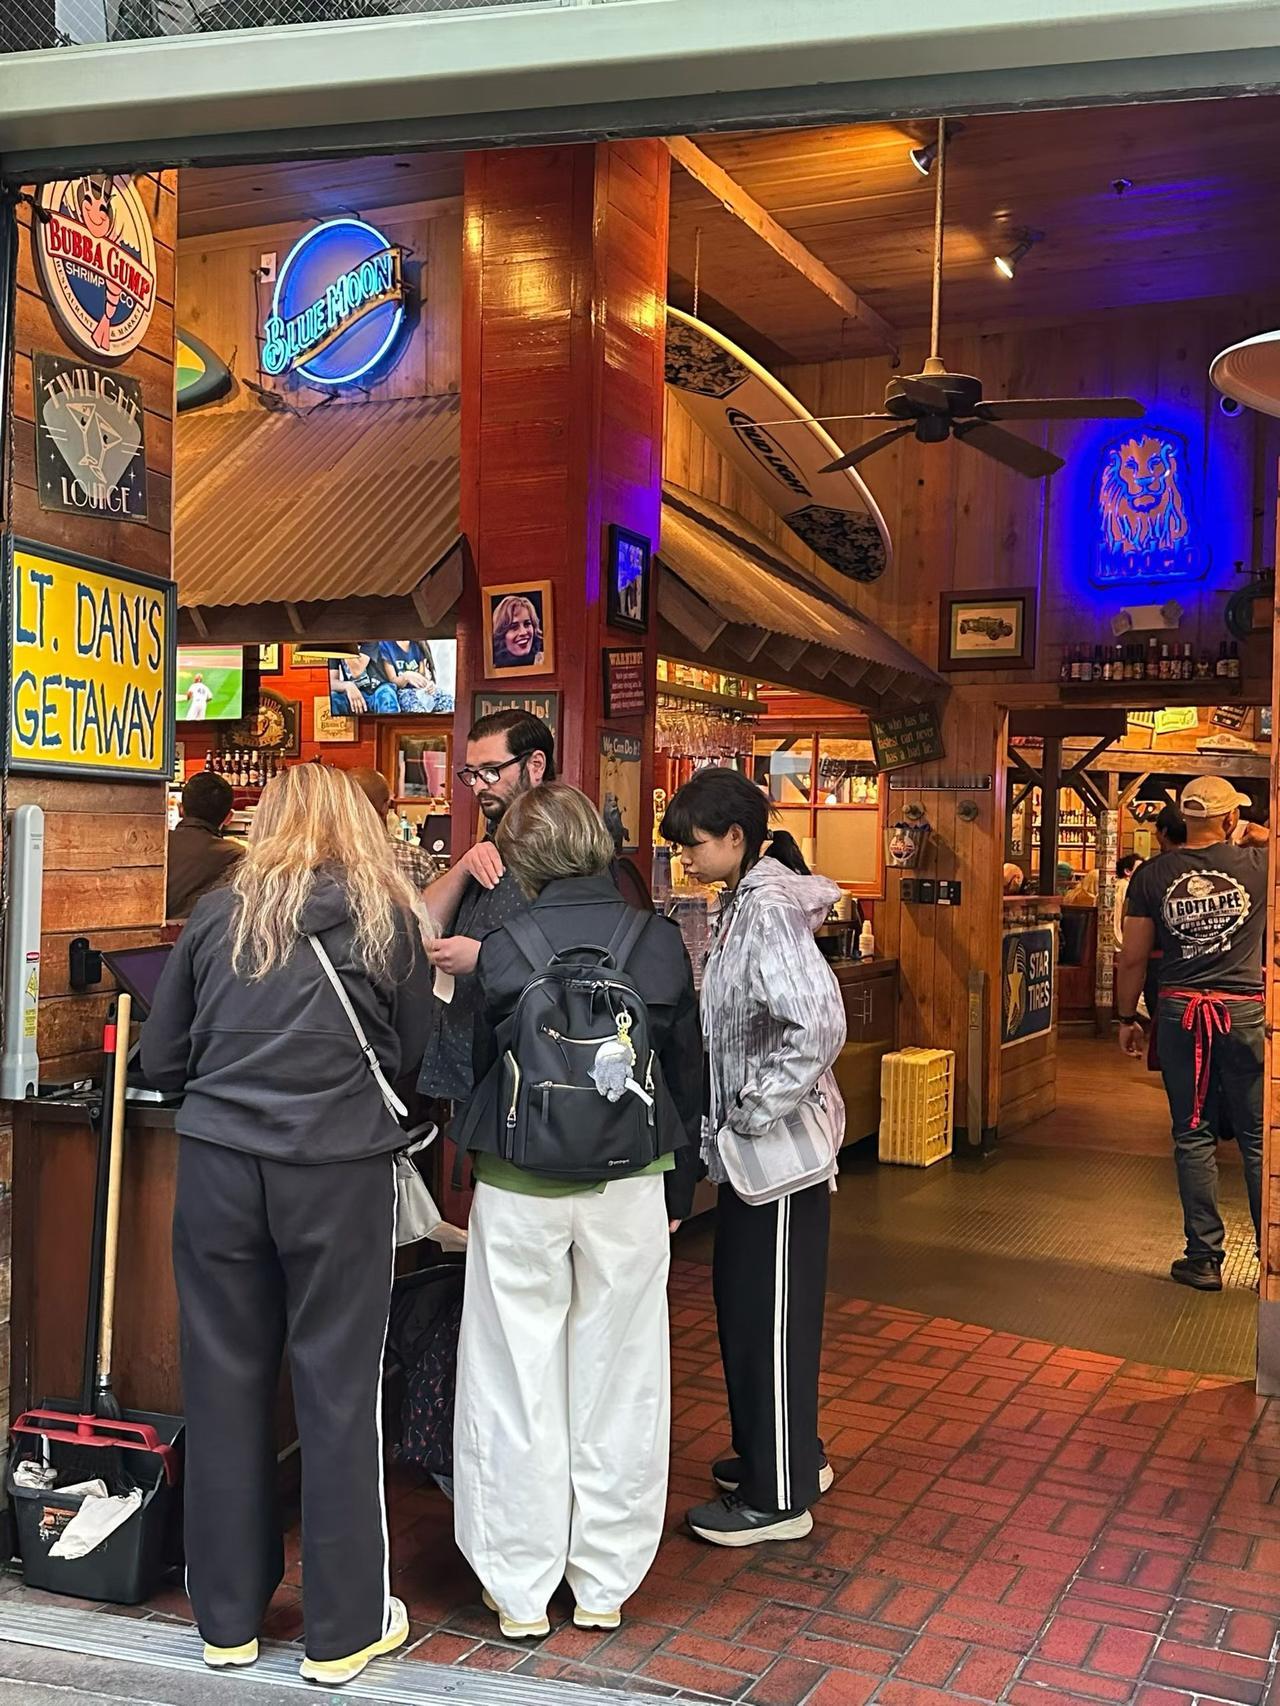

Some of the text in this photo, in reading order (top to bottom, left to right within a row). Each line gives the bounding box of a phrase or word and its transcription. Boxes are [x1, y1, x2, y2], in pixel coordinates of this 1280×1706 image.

[50, 217, 151, 301] BUBBA GUMP
[65, 261, 105, 288] SHRIMP
[262, 253, 393, 375] BLUE MOON
[43, 368, 141, 425] TWILIGHT
[61, 476, 132, 514] LOUNGE
[15, 566, 162, 671] LT. DAN'S
[14, 670, 162, 760] GETAWAY
[1176, 897, 1217, 917] GOTTA
[1218, 891, 1242, 909] PEE
[1029, 950, 1049, 980] STAR
[1028, 980, 1050, 1012] TIRES
